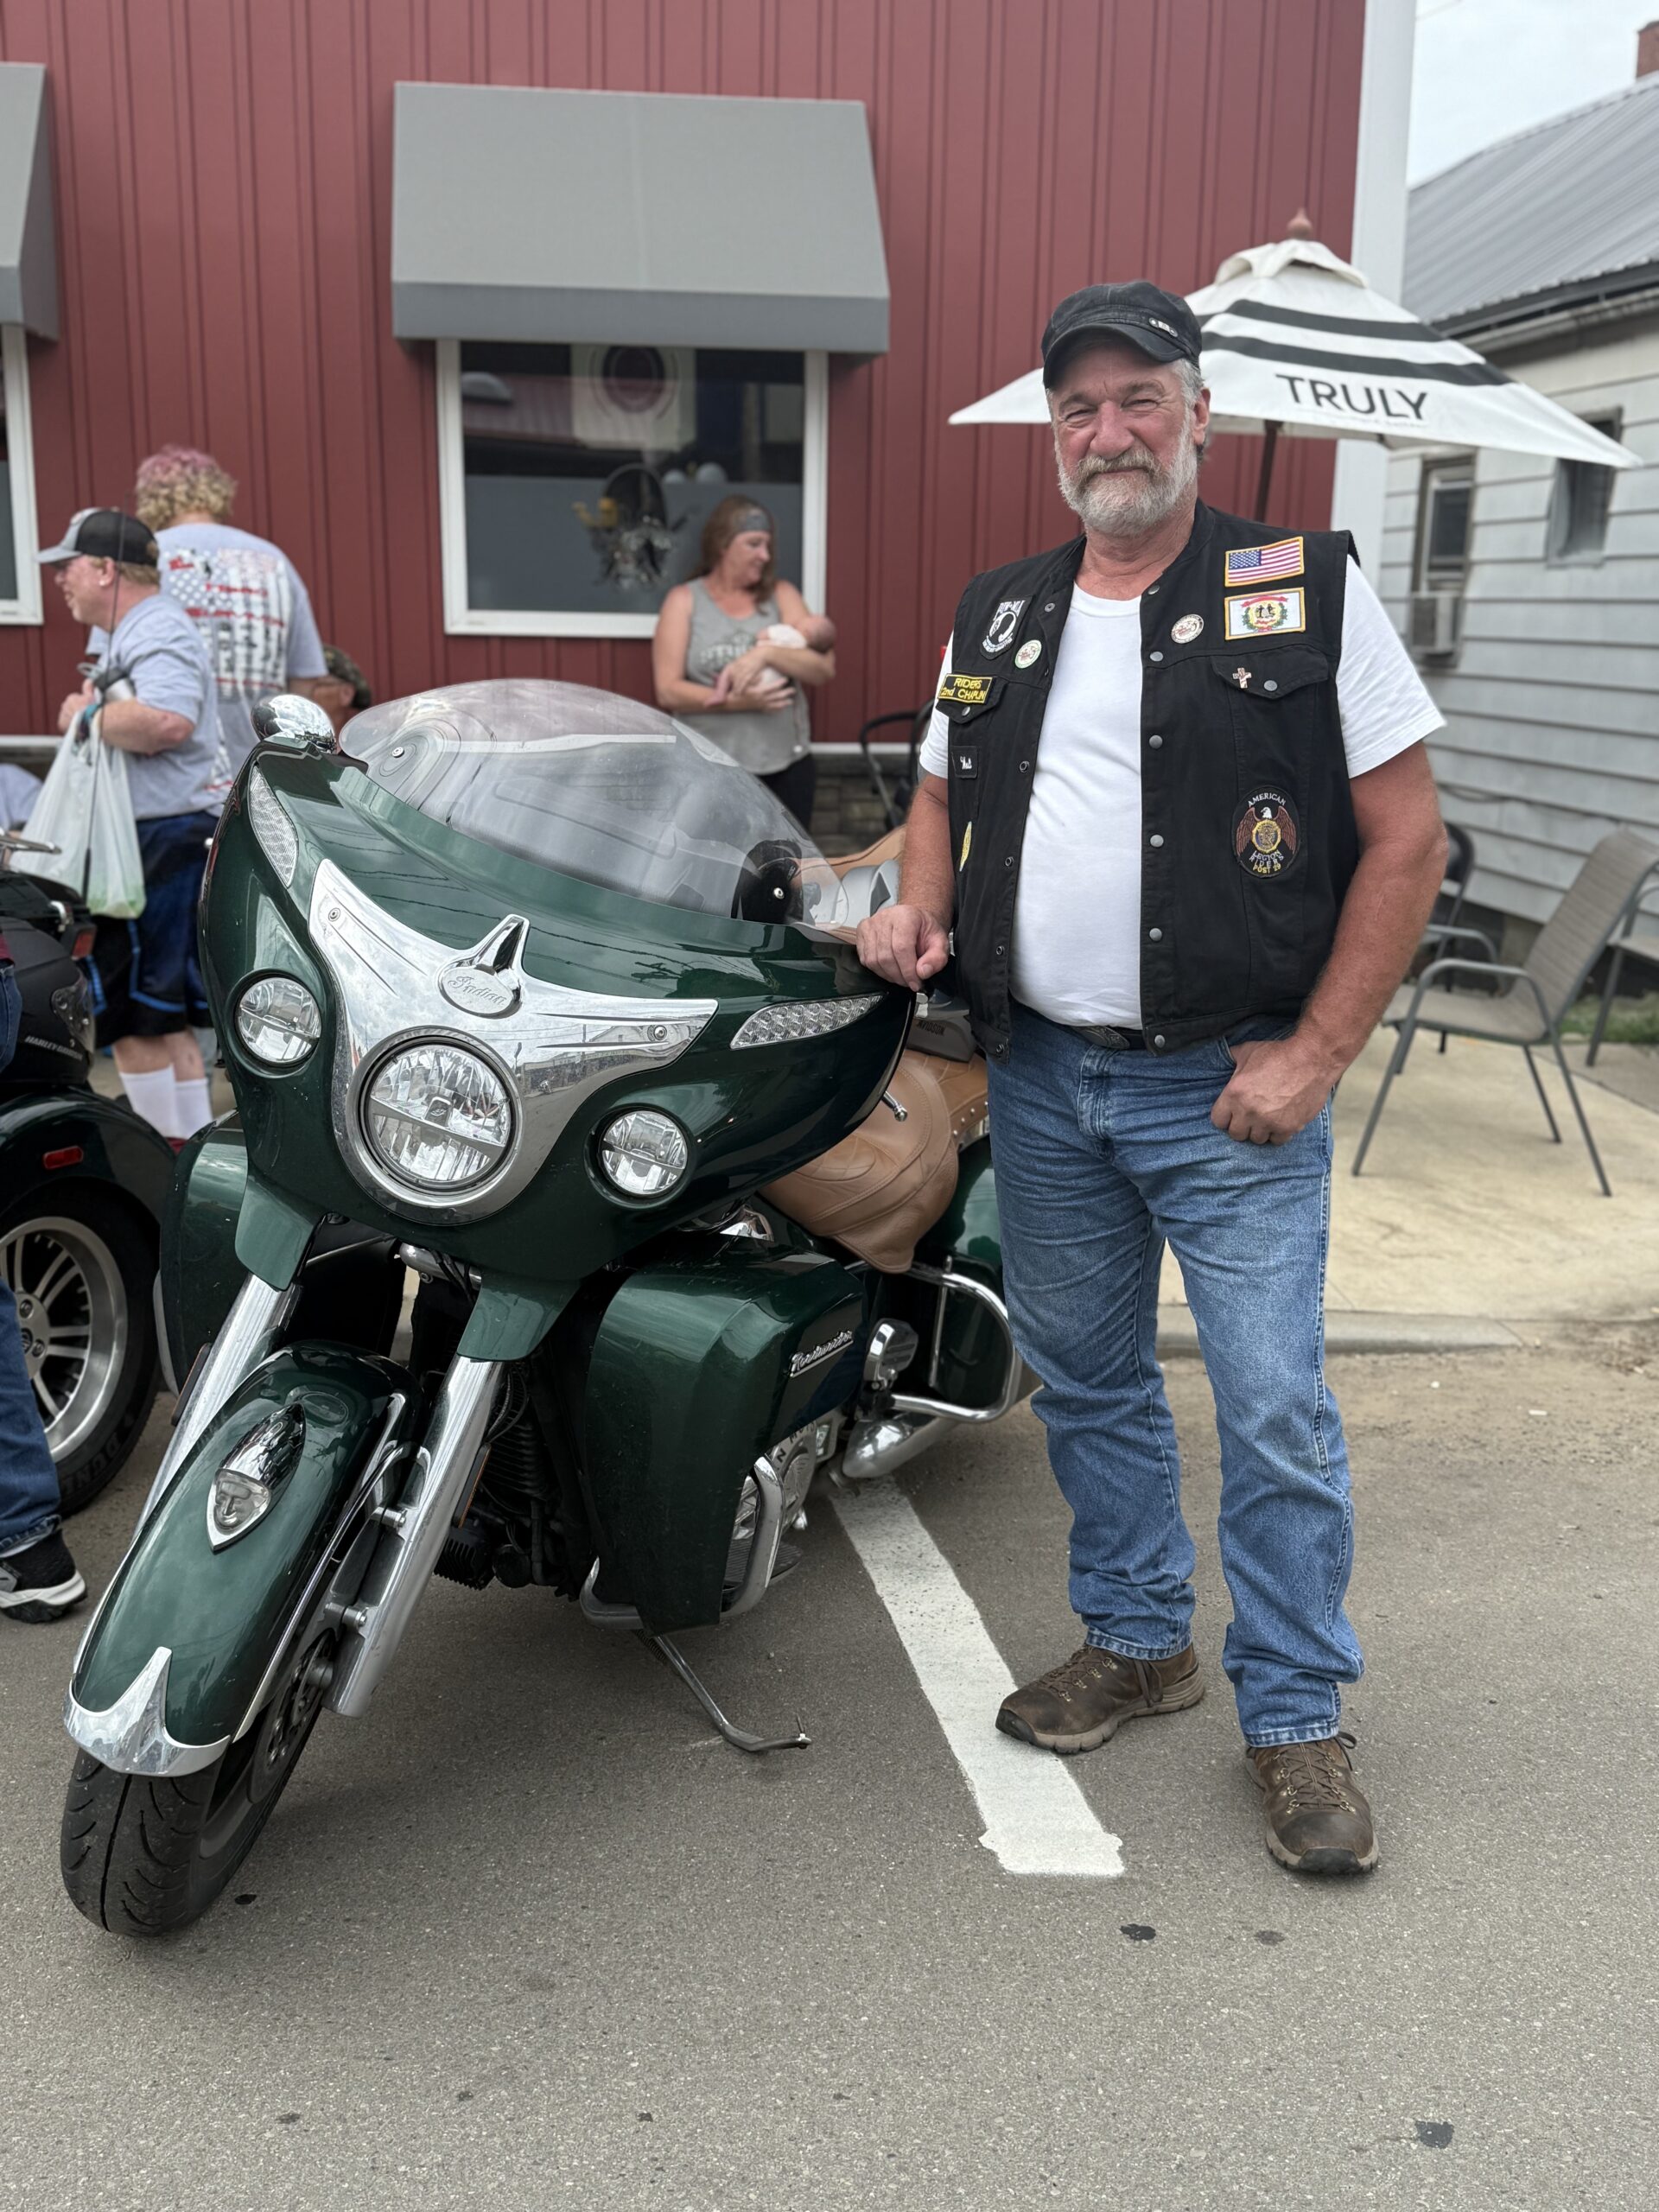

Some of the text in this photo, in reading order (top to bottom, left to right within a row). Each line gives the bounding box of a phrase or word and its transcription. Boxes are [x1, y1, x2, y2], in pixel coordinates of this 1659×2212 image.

[1275, 373, 1427, 420] TRULY
[940, 686, 956, 696] 2nd
[953, 677, 982, 690] RIDERS
[1248, 792, 1287, 808] AMERICAN
[1249, 854, 1284, 869] RIDERS
[1252, 849, 1282, 861] LEGION
[1252, 864, 1271, 874] POST
[447, 976, 507, 1006] Indian
[61, 1432, 122, 1494] DUNL
